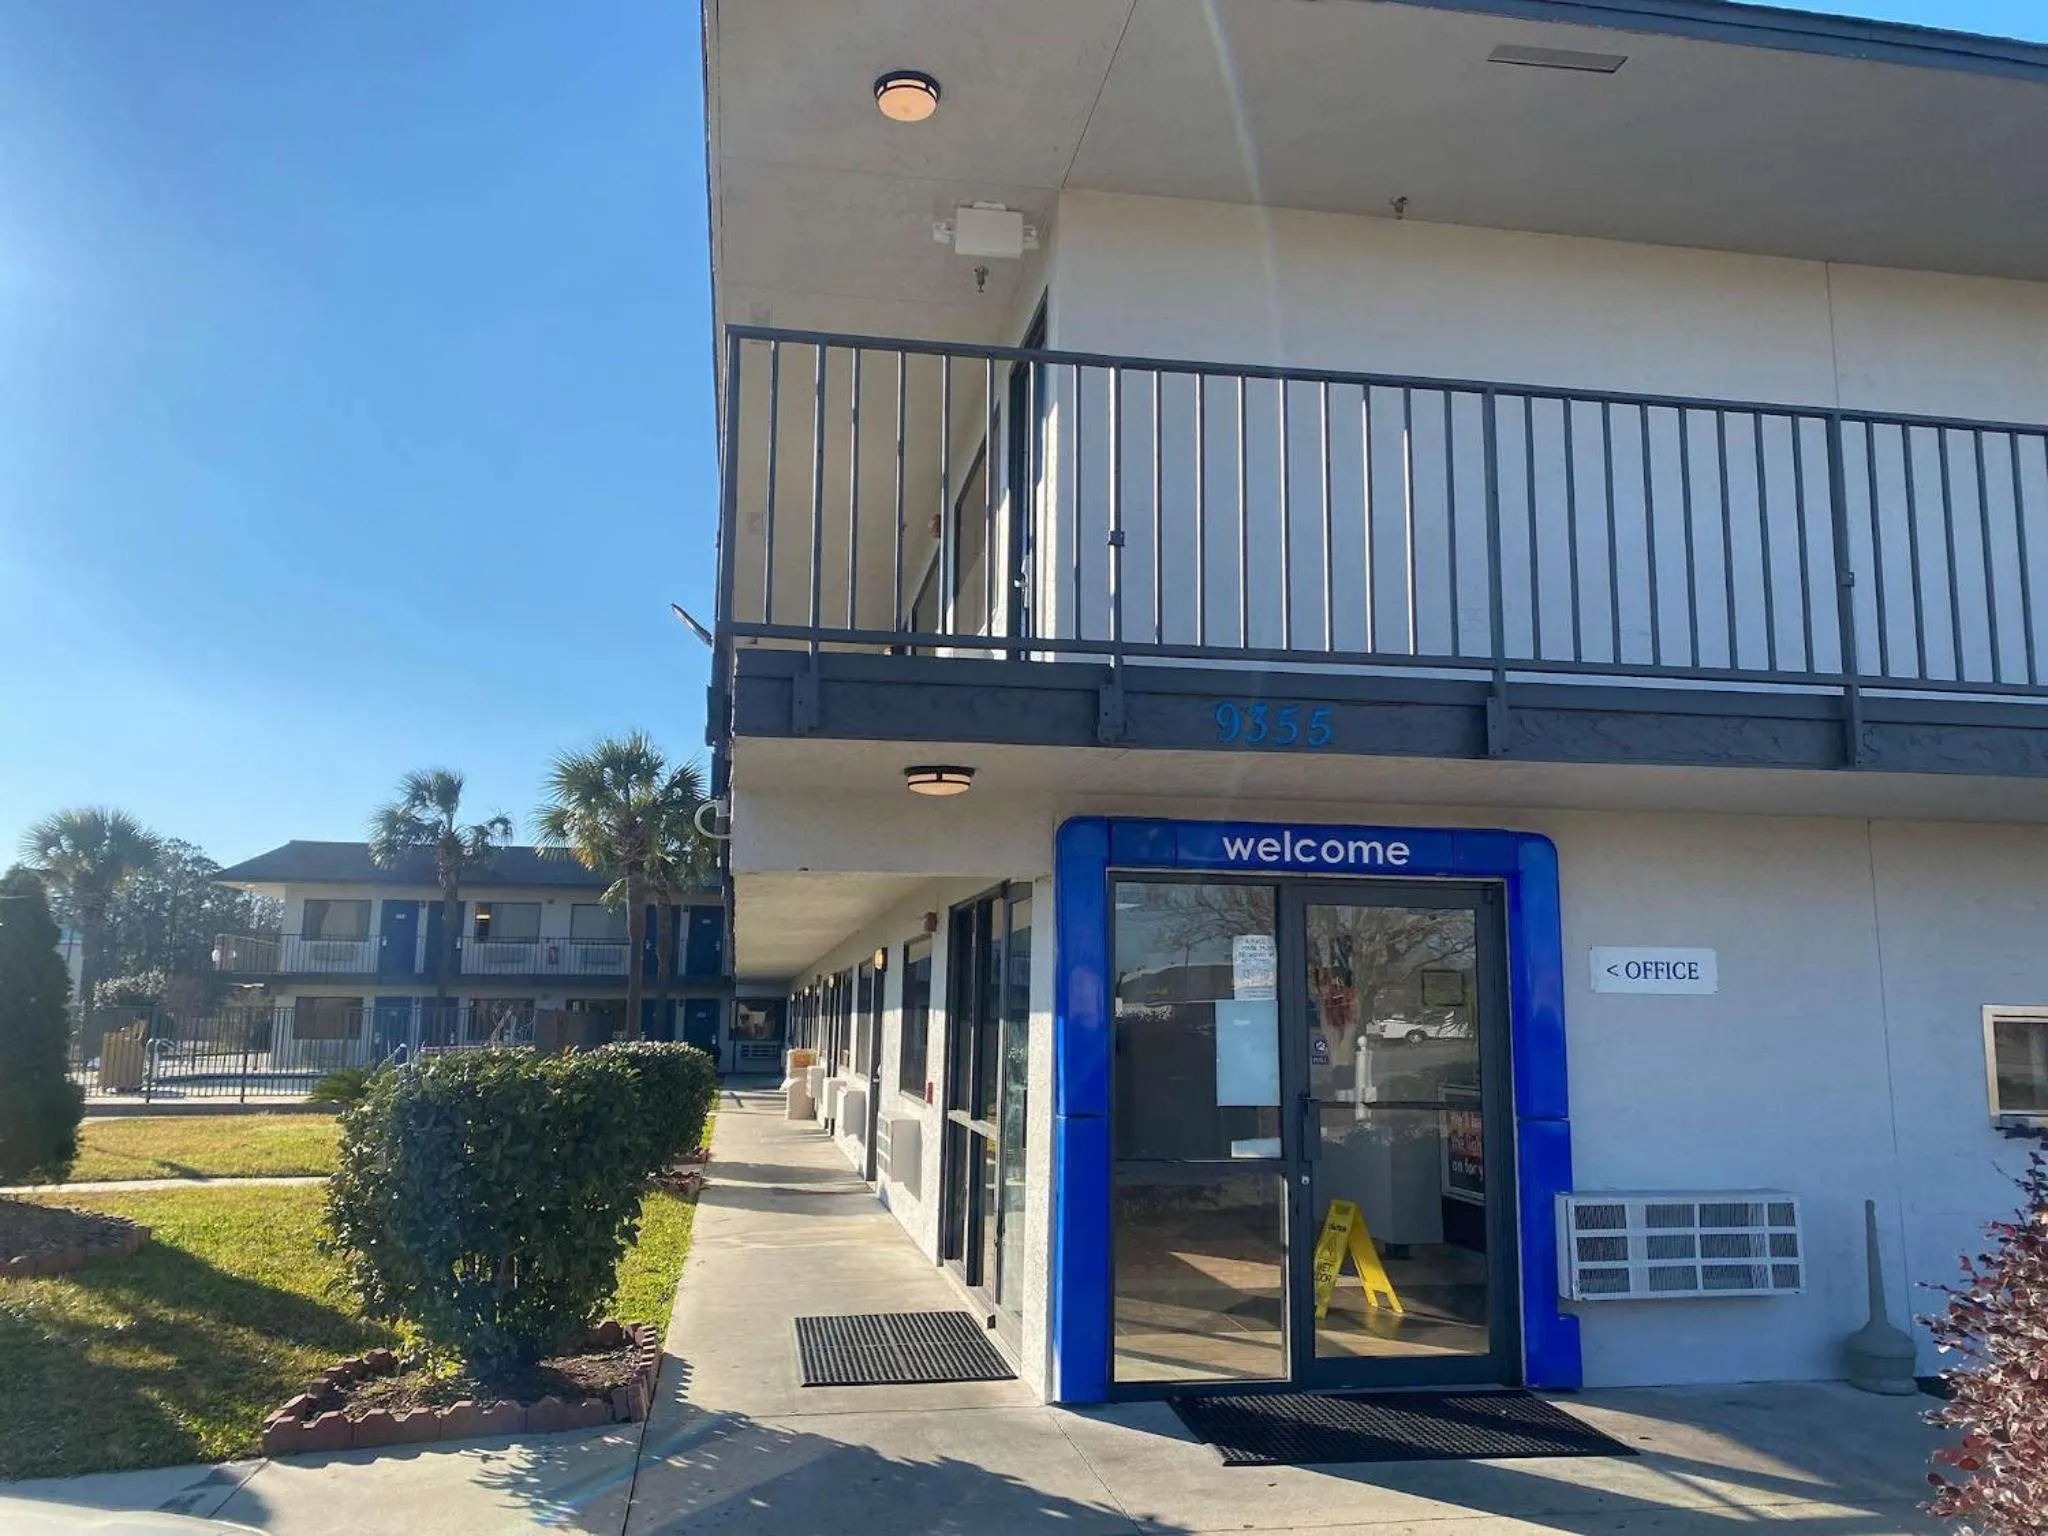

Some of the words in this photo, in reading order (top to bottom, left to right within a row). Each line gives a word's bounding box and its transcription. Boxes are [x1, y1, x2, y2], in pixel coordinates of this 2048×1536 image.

[1215, 703, 1333, 747] 9355
[1222, 830, 1410, 865] welcome
[1625, 960, 1699, 980] OFFICE
